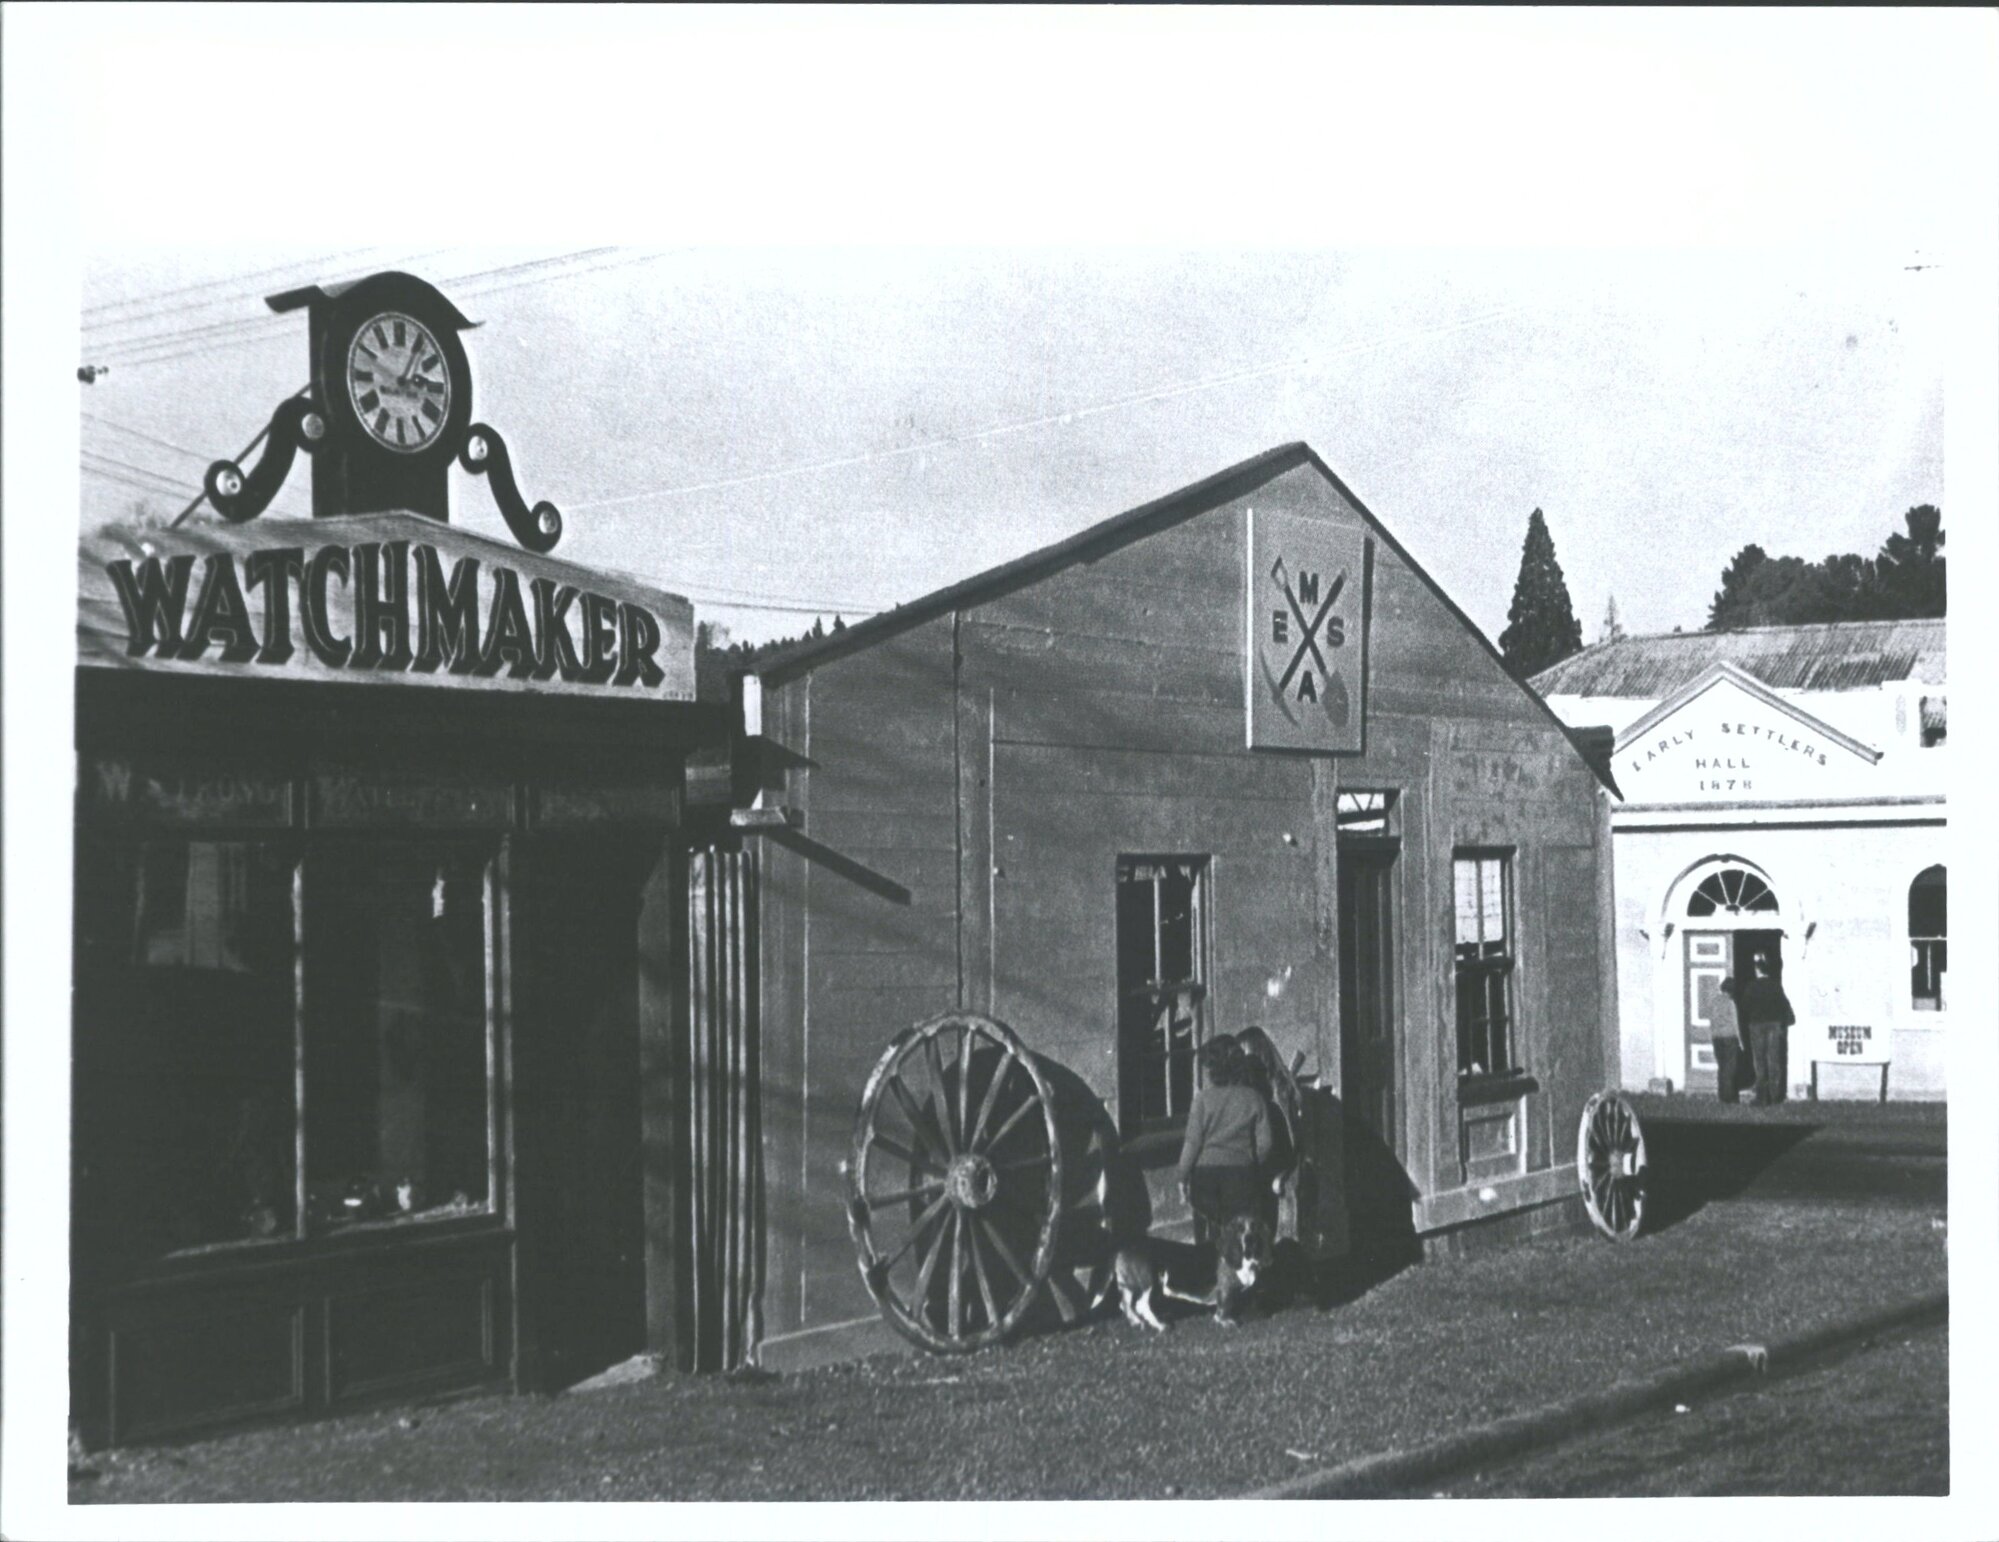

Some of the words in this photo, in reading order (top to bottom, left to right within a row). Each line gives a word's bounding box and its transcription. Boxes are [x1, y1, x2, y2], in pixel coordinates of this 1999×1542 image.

[106, 540, 666, 687] WATCHMAKER
[1721, 722, 1827, 767] SETTLERS
[1695, 758, 1751, 769] HALL
[1828, 1025, 1872, 1040] MUSEUM
[1837, 1040, 1863, 1055] OPEN
